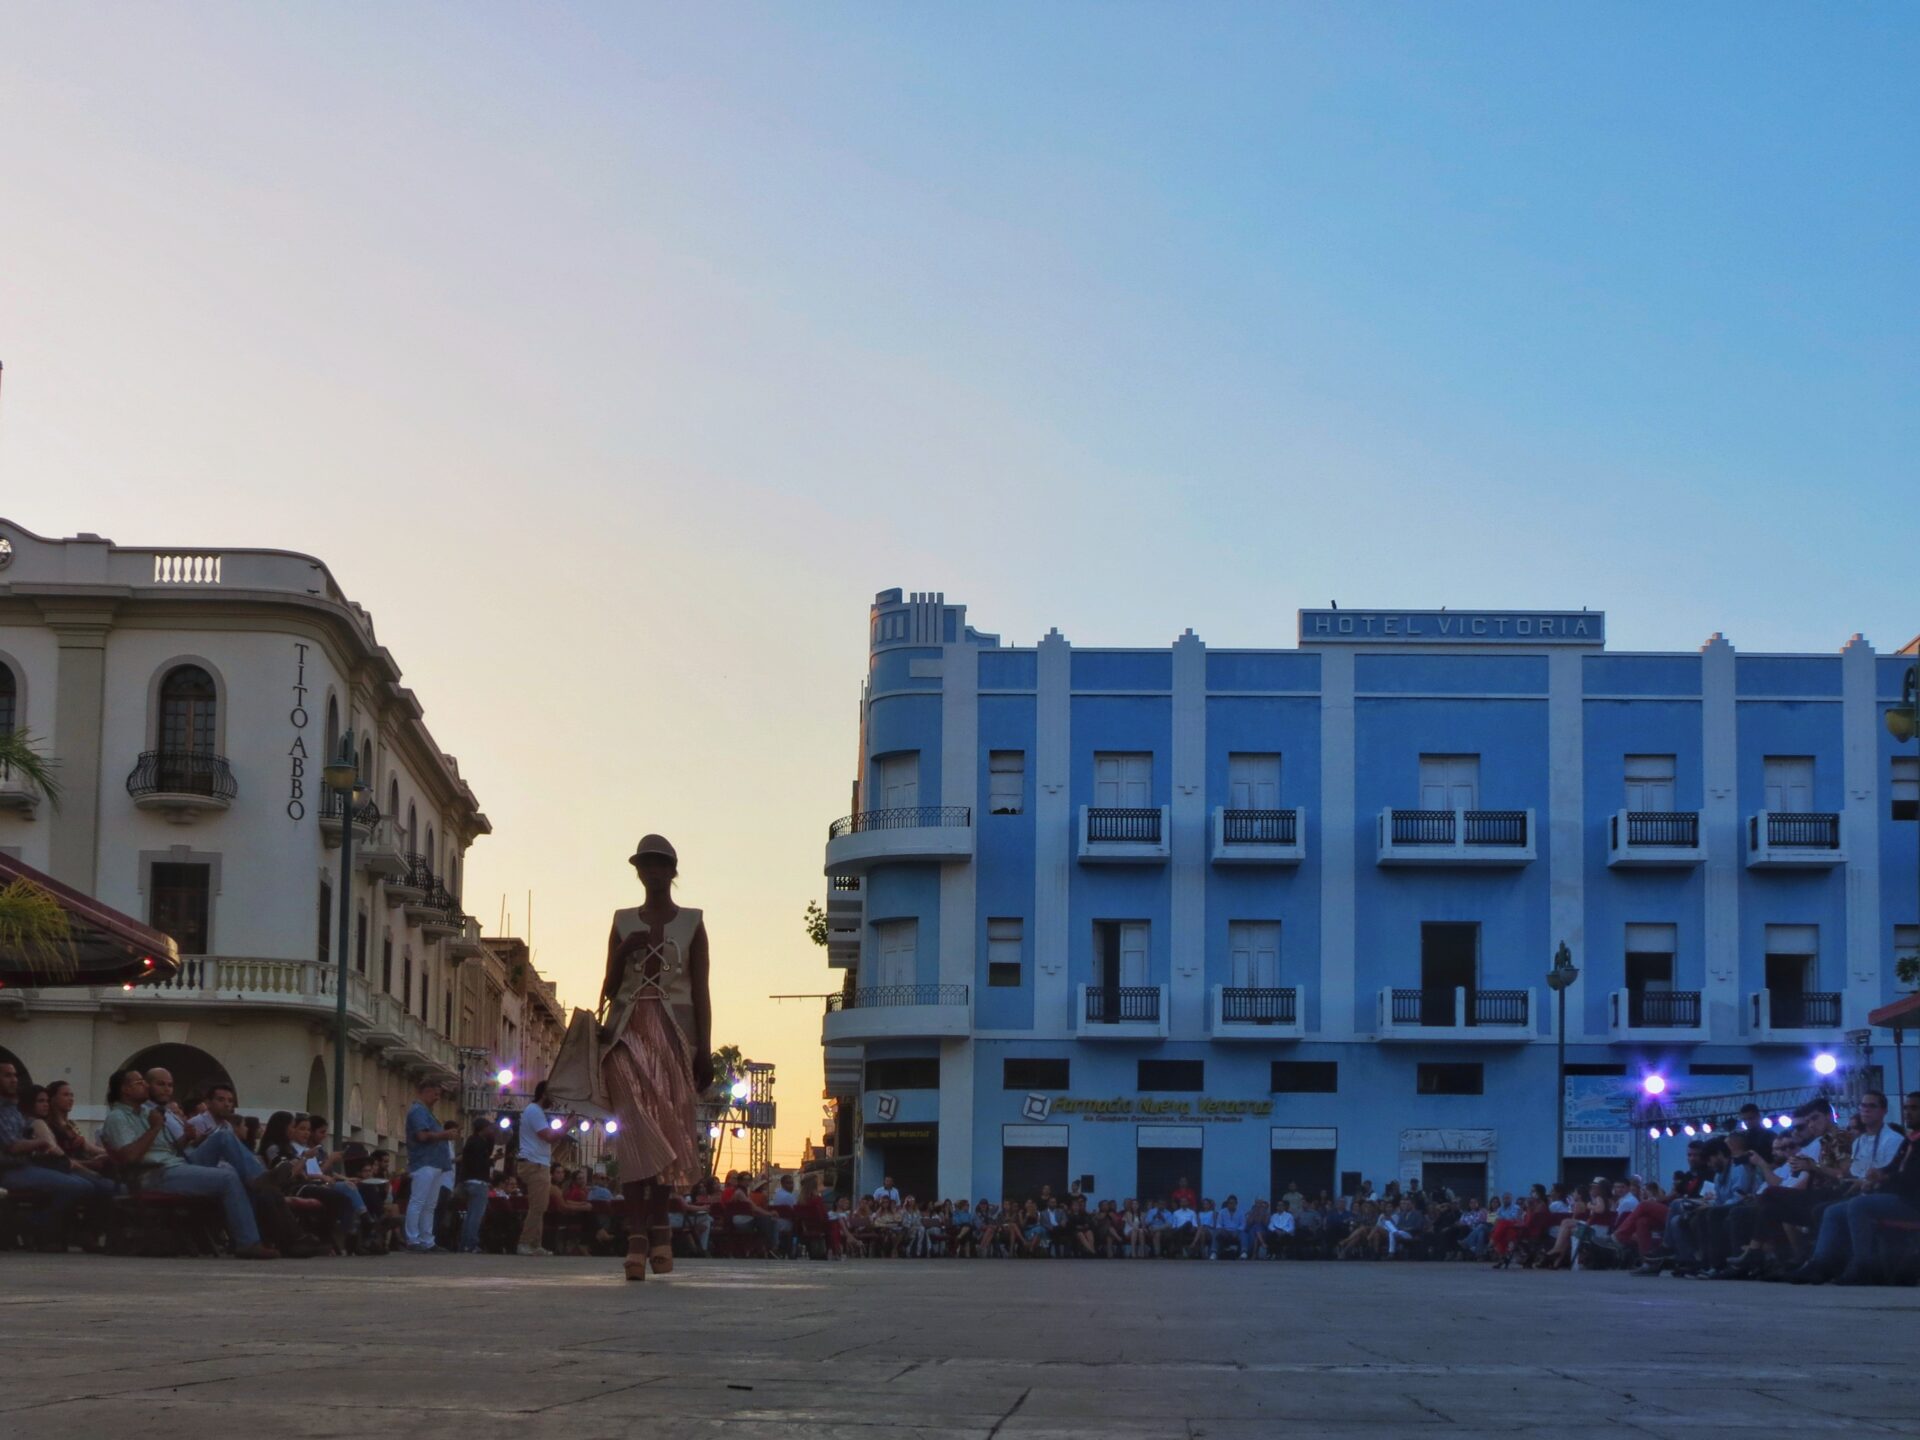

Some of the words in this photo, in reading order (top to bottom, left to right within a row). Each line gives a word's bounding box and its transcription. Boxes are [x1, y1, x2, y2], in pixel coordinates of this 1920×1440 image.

[1315, 616, 1422, 634] HOTEL
[1438, 617, 1589, 635] VICTORIA
[290, 643, 309, 729] TITO
[287, 735, 309, 821] ABBO
[1051, 1096, 1132, 1114] Farmacia
[1138, 1096, 1189, 1115] Nueva
[1197, 1097, 1274, 1116] Veracruz
[1567, 1133, 1612, 1144] SISTEMA
[1613, 1133, 1625, 1144] DE
[1571, 1144, 1618, 1155] APARTADO
